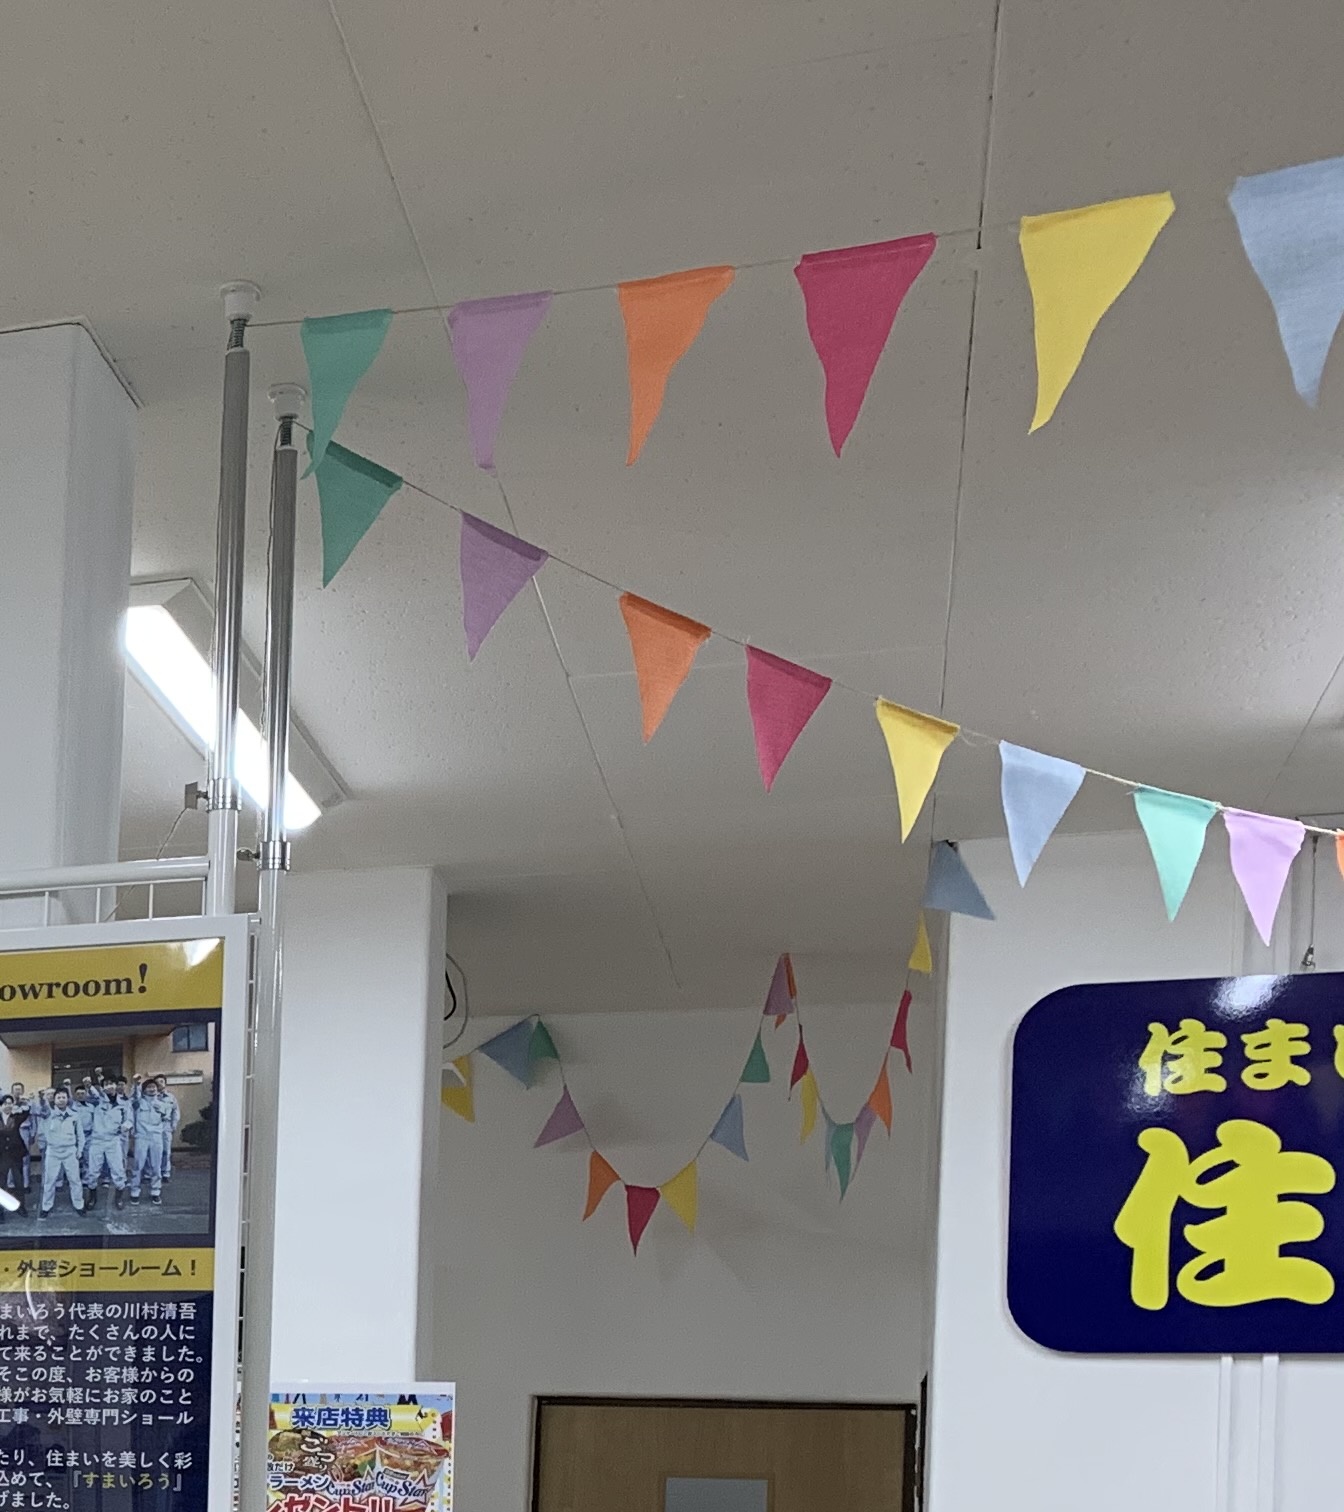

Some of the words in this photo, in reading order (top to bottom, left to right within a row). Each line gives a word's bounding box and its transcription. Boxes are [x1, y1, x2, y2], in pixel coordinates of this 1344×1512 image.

[1138, 1018, 1344, 1097] 住ま
[1113, 1119, 1337, 1311] 住
[292, 1406, 391, 1429] 来店特典
